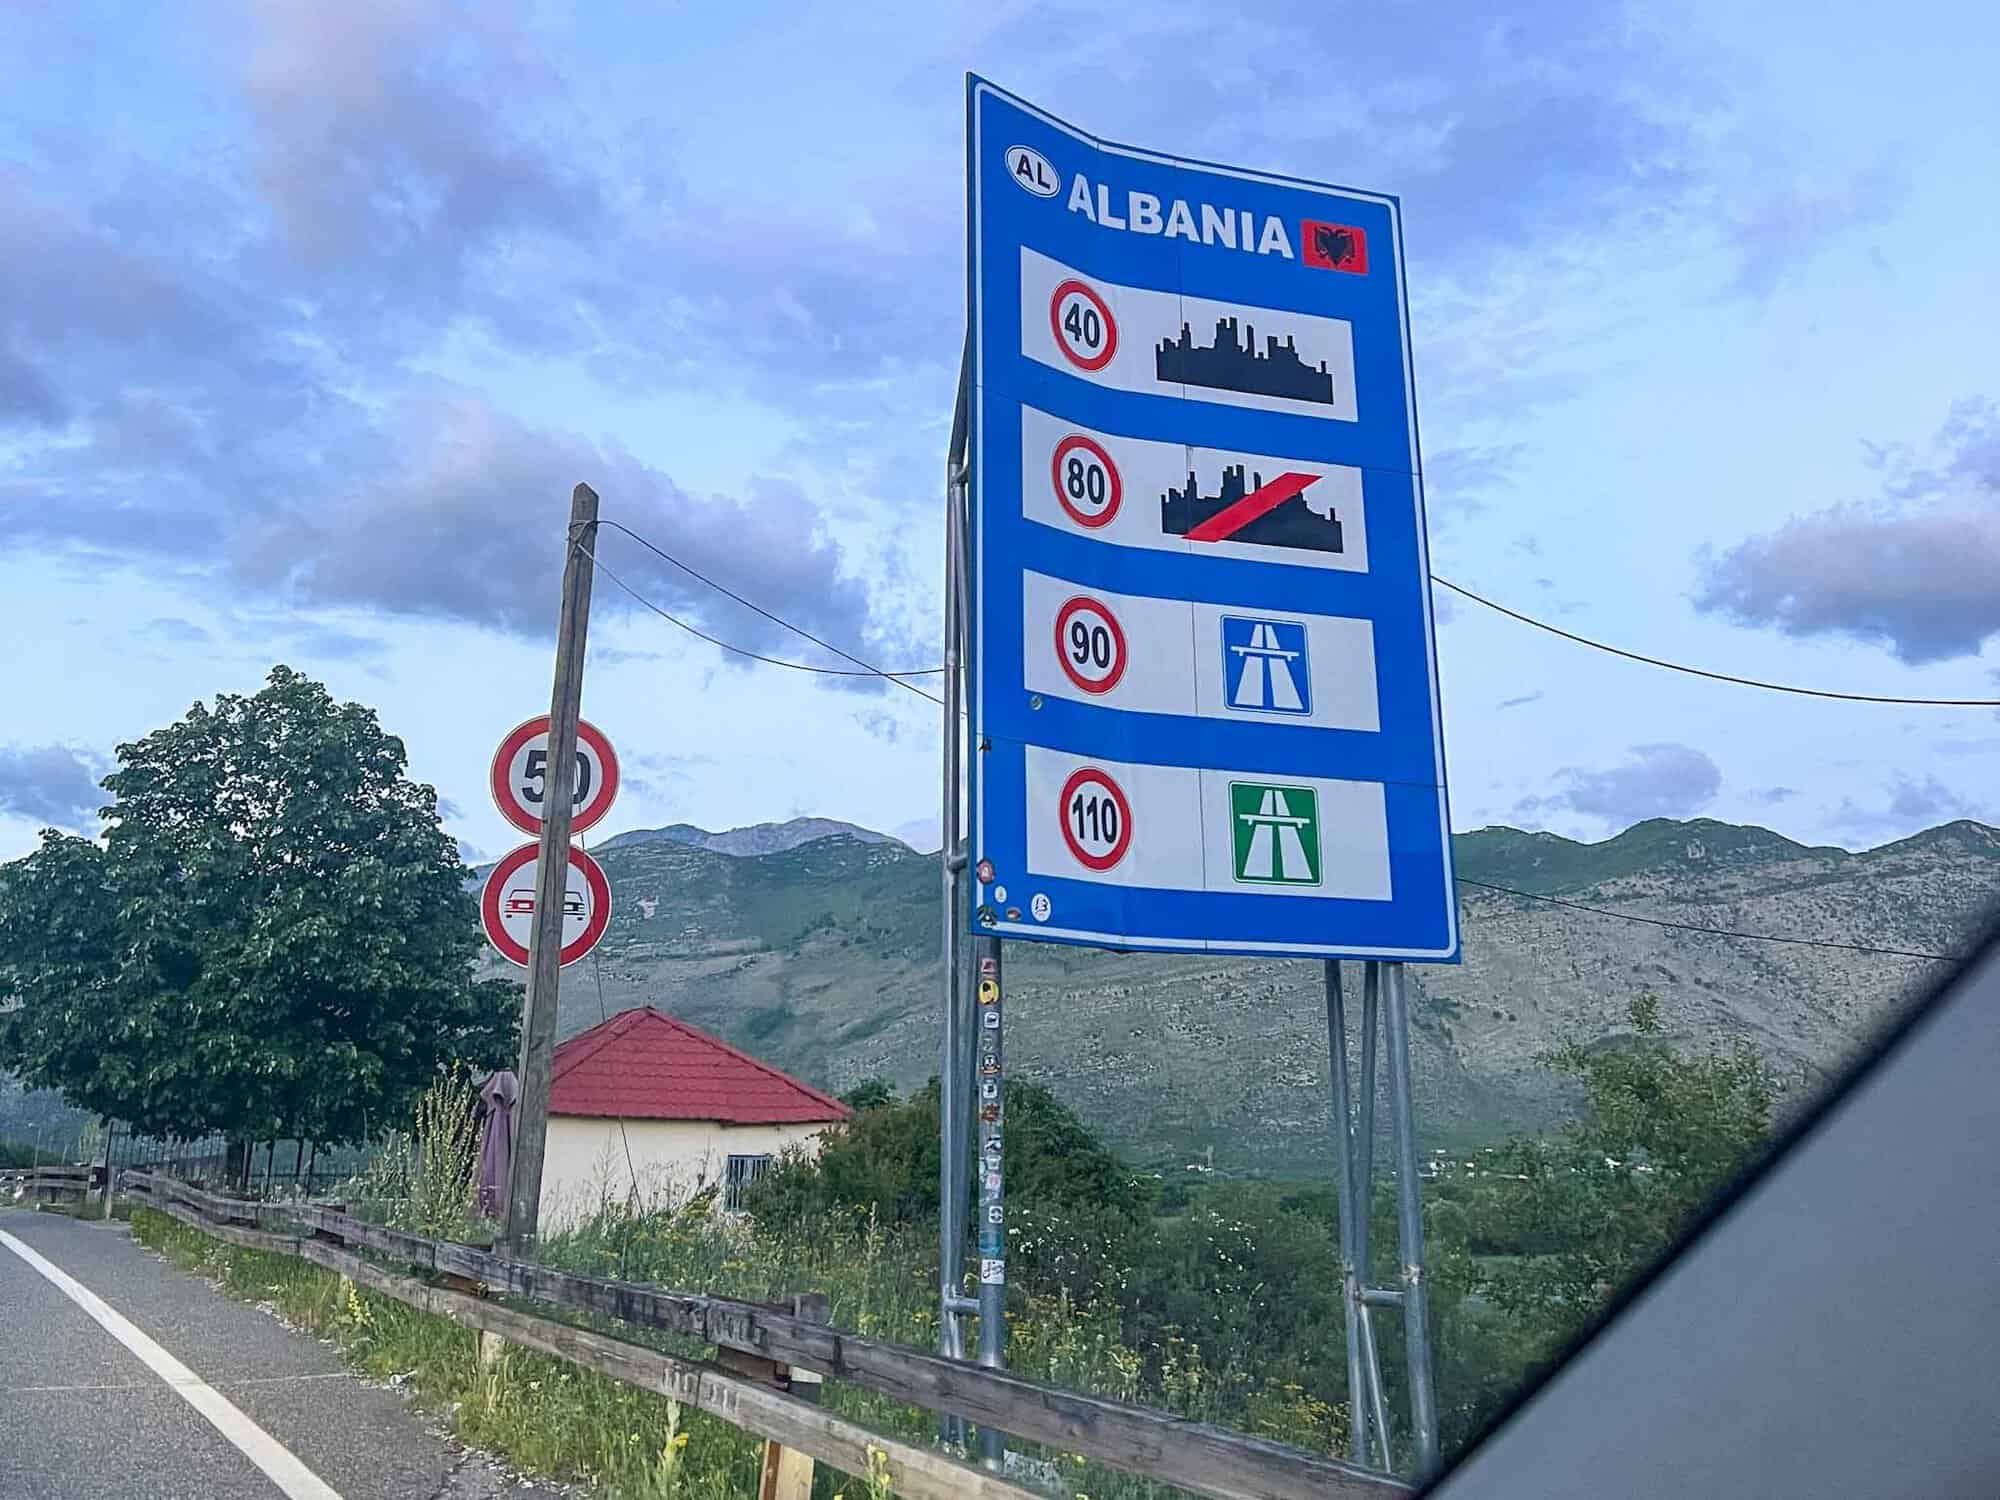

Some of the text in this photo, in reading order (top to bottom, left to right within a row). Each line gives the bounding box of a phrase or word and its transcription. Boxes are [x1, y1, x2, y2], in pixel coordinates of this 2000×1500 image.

[1016, 155, 1052, 190] AL
[1067, 172, 1295, 259] ALBANIA
[1064, 302, 1101, 349] 40
[1067, 457, 1105, 504] 80
[1071, 621, 1110, 668] 90
[1072, 794, 1117, 844] 110
